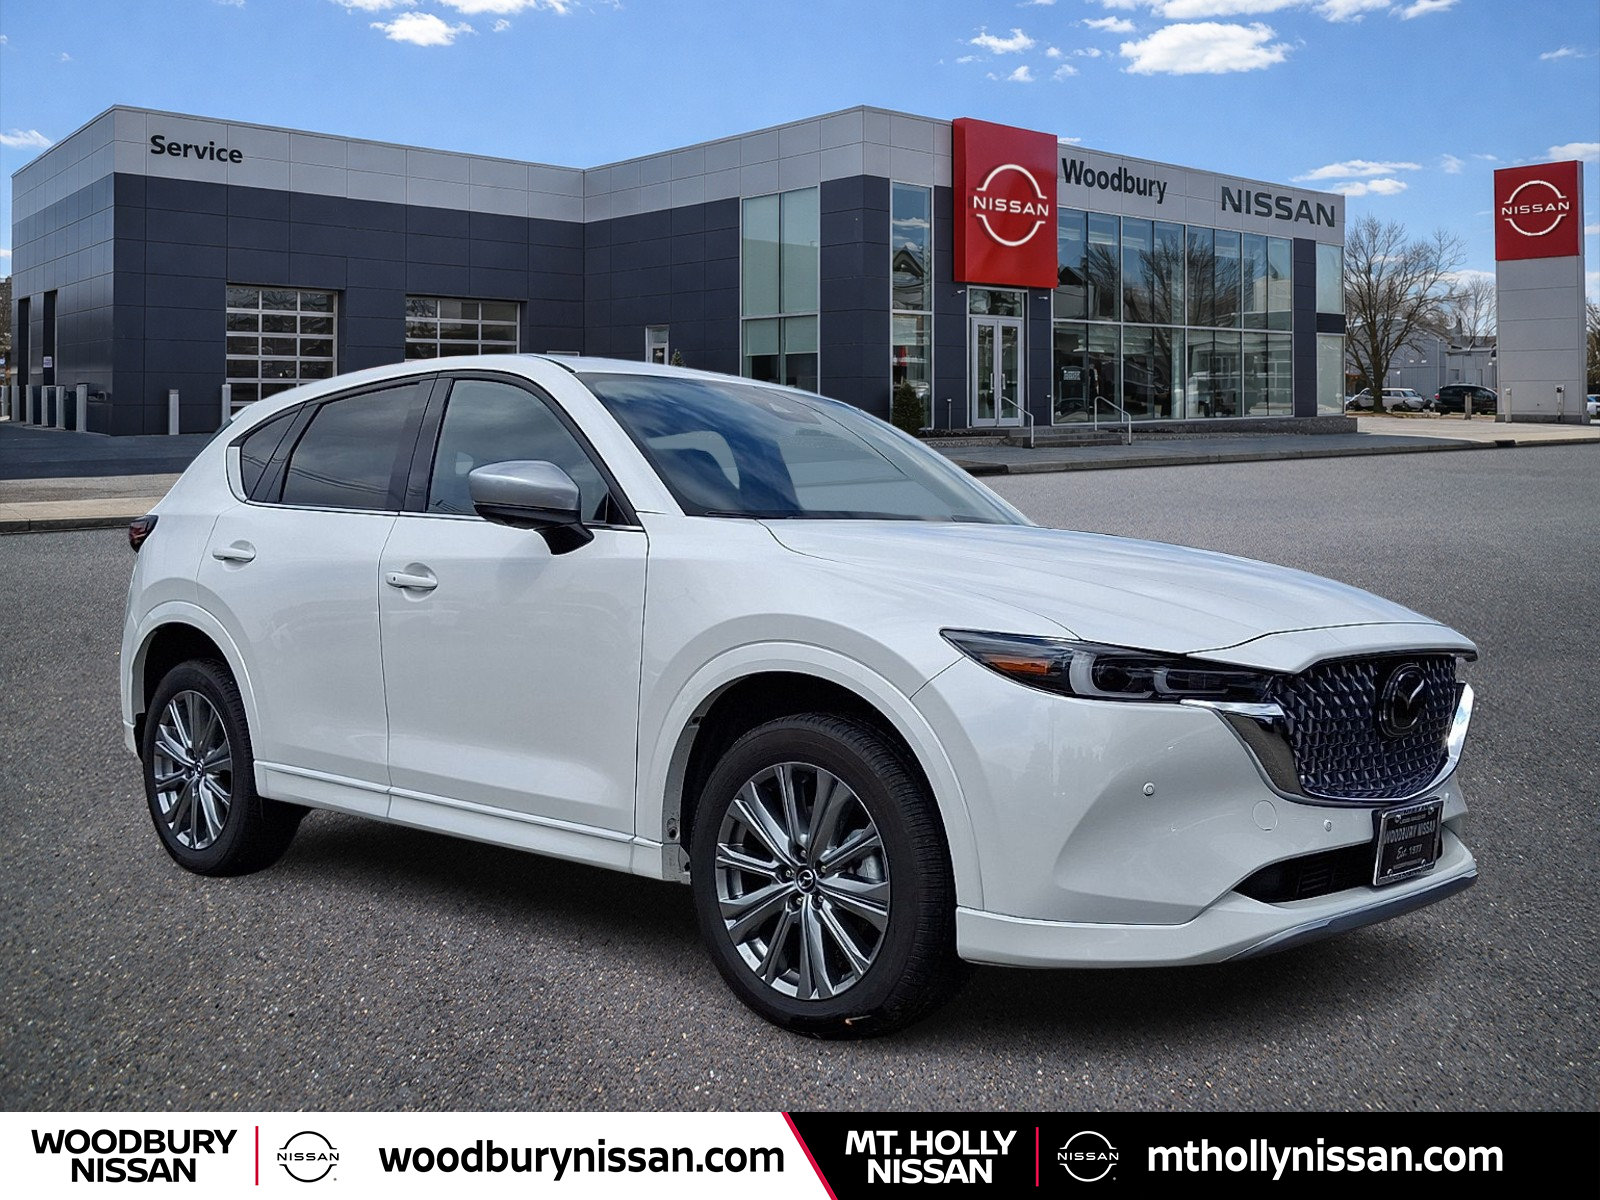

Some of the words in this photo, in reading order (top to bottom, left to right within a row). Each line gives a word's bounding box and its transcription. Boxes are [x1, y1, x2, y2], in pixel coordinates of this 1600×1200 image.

[150, 134, 243, 164] Service
[1061, 157, 1167, 204] Woodbury
[973, 195, 1049, 217] NISSAN
[1221, 186, 1335, 228] NISSAN
[1502, 201, 1570, 216] NISSAN
